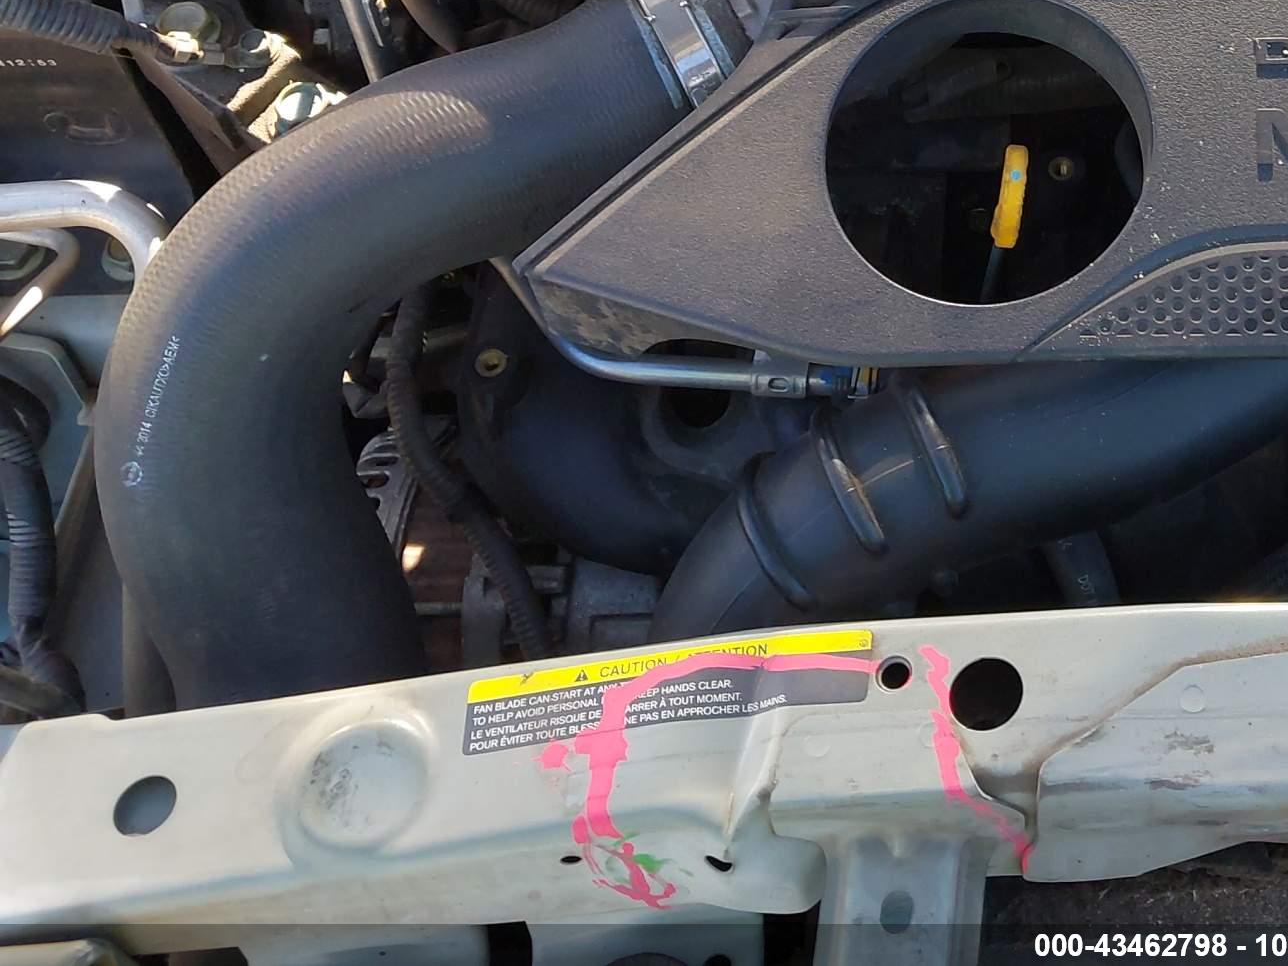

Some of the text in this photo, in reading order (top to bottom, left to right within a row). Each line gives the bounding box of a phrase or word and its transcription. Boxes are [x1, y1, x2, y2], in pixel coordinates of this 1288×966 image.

[600, 656, 668, 678] CAUTION
[471, 692, 743, 740] LE VENTILATEUR RISQUE DE ARRER À TOUT MOMENT.
[472, 716, 486, 727] TO
[488, 712, 514, 725] HELP
[515, 706, 545, 720] AVOID
[547, 698, 599, 714] PERSONAL
[661, 682, 696, 695] HANDS
[698, 679, 733, 690] CLEAR.
[474, 701, 493, 715] FAN
[495, 697, 527, 712] BLADE
[529, 694, 550, 706] CAN
[551, 688, 582, 702] START
[584, 686, 595, 697] AT
[469, 739, 498, 752] POUR
[499, 733, 533, 747] ÉVITER
[535, 726, 567, 740] TOUTE
[639, 711, 659, 723] PAS
[660, 709, 675, 719] EN
[677, 704, 740, 717] APPROCHER
[741, 701, 760, 713] LES
